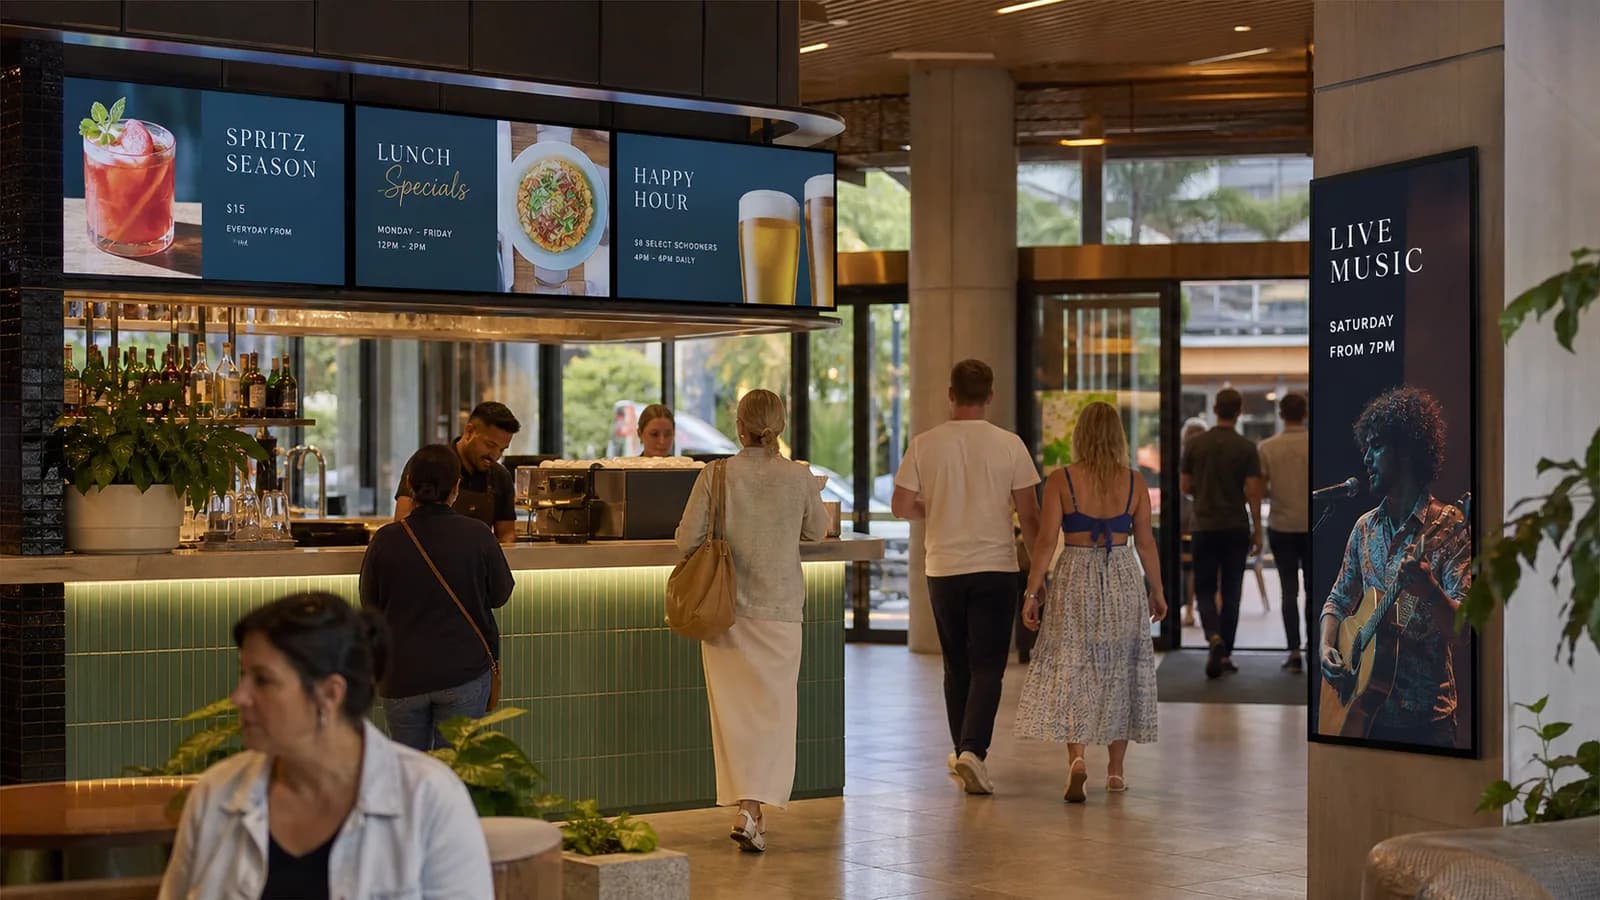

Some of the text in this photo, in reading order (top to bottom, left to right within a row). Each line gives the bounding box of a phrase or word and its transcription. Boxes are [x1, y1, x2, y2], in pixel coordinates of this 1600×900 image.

[227, 127, 305, 152] SPRITZ
[378, 143, 450, 166] LUNCH
[227, 153, 316, 178] SEASON
[378, 164, 470, 207] Specials
[634, 167, 694, 188] HAPPY
[226, 203, 245, 213] $15
[634, 190, 688, 211] HOUR
[226, 224, 292, 236] EVERYDAY FROM
[377, 226, 413, 235] MONDAY
[424, 228, 453, 238] FRIDAY
[1330, 218, 1392, 250] LIVE
[377, 241, 399, 249] 12PM
[409, 243, 426, 251] 2PM
[645, 240, 672, 249] SELECT
[674, 241, 718, 252] SCHOONERS
[634, 253, 649, 262] 4PM
[658, 254, 673, 263] 6PM
[675, 256, 696, 265] DAILY
[1330, 247, 1423, 284] MUSIC
[1329, 314, 1394, 333] SATURDAY
[1329, 339, 1395, 358] FROM 7PM
